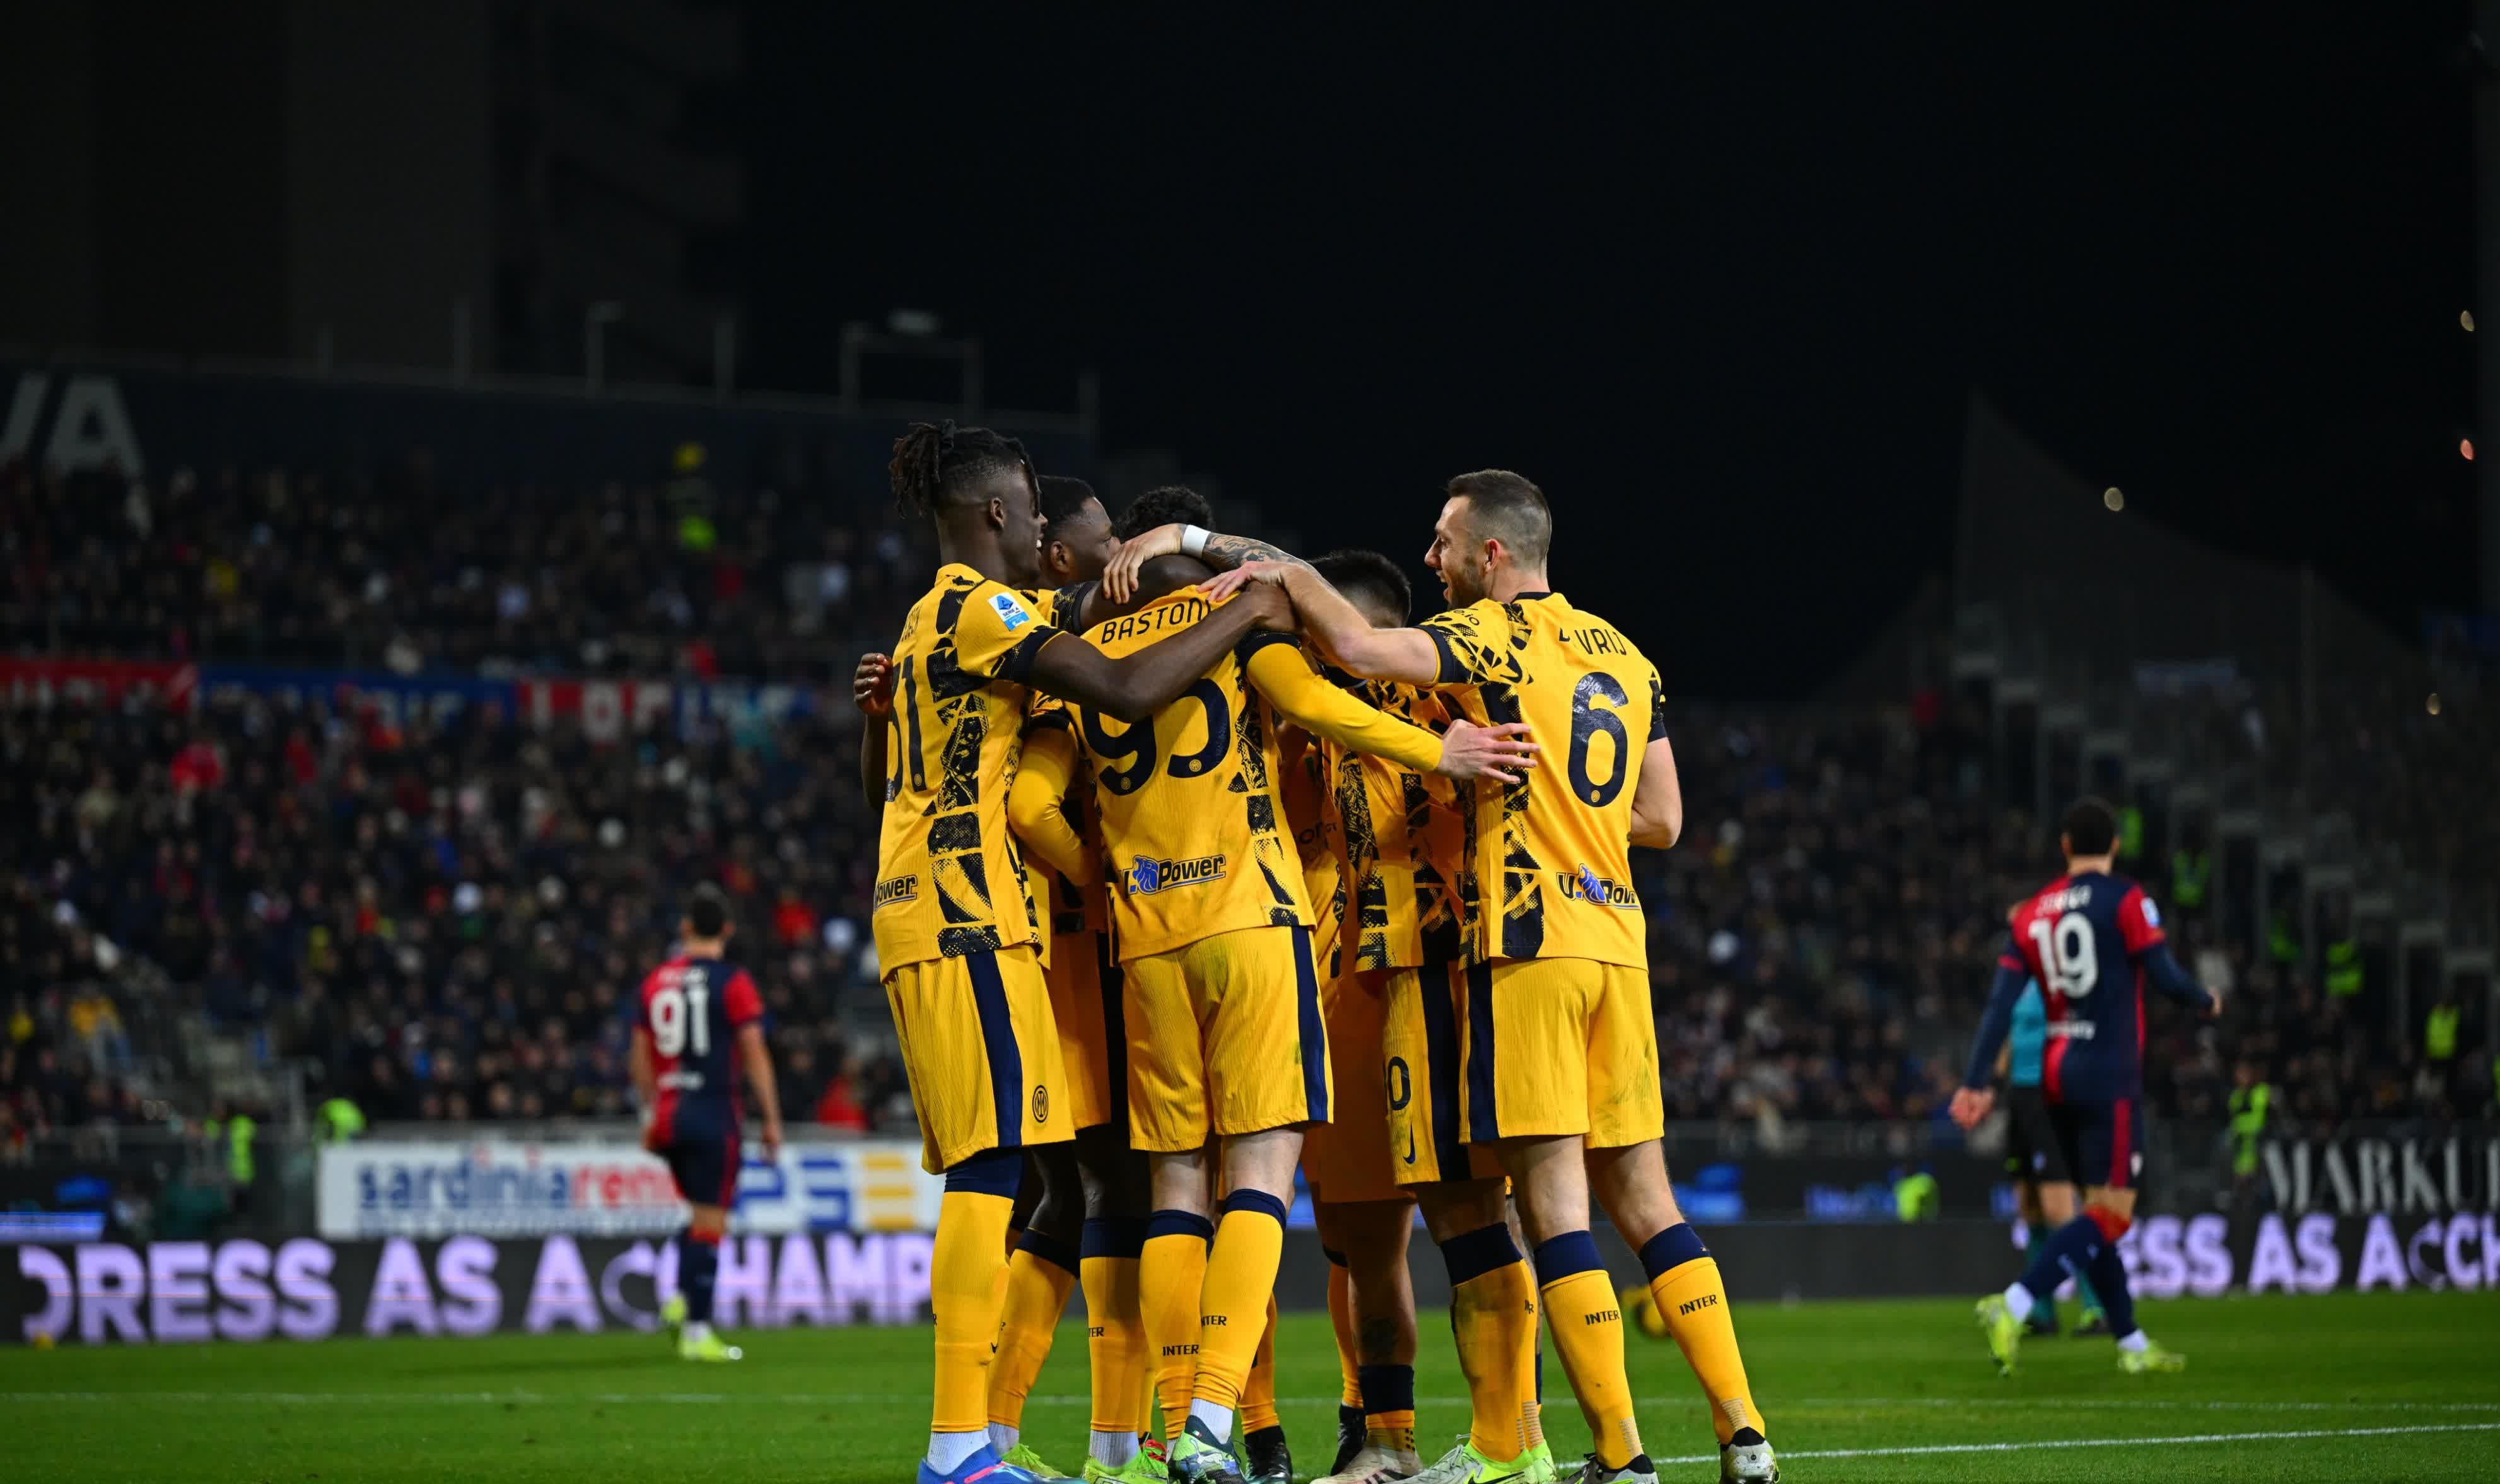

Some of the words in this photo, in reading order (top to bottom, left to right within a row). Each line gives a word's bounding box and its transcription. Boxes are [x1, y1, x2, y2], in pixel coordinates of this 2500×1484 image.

[1003, 608, 1015, 616] SERIE
[1574, 628, 1627, 655] VRIJ
[1568, 672, 1628, 807] 6
[879, 877, 915, 901] ower
[1157, 856, 1224, 891] Power
[2028, 911, 2099, 999] 19
[649, 984, 711, 1058] 91
[1387, 1056, 1411, 1110] 0
[358, 1142, 684, 1208] sardiniaren
[2246, 1211, 2343, 1295] AS
[365, 1236, 503, 1337] AS
[1201, 1315, 1227, 1326] NTER
[1585, 1310, 1620, 1325] INTER
[1679, 1294, 1717, 1316] INTER
[1089, 1326, 1104, 1338] TER
[1163, 1345, 1199, 1357] INTER
